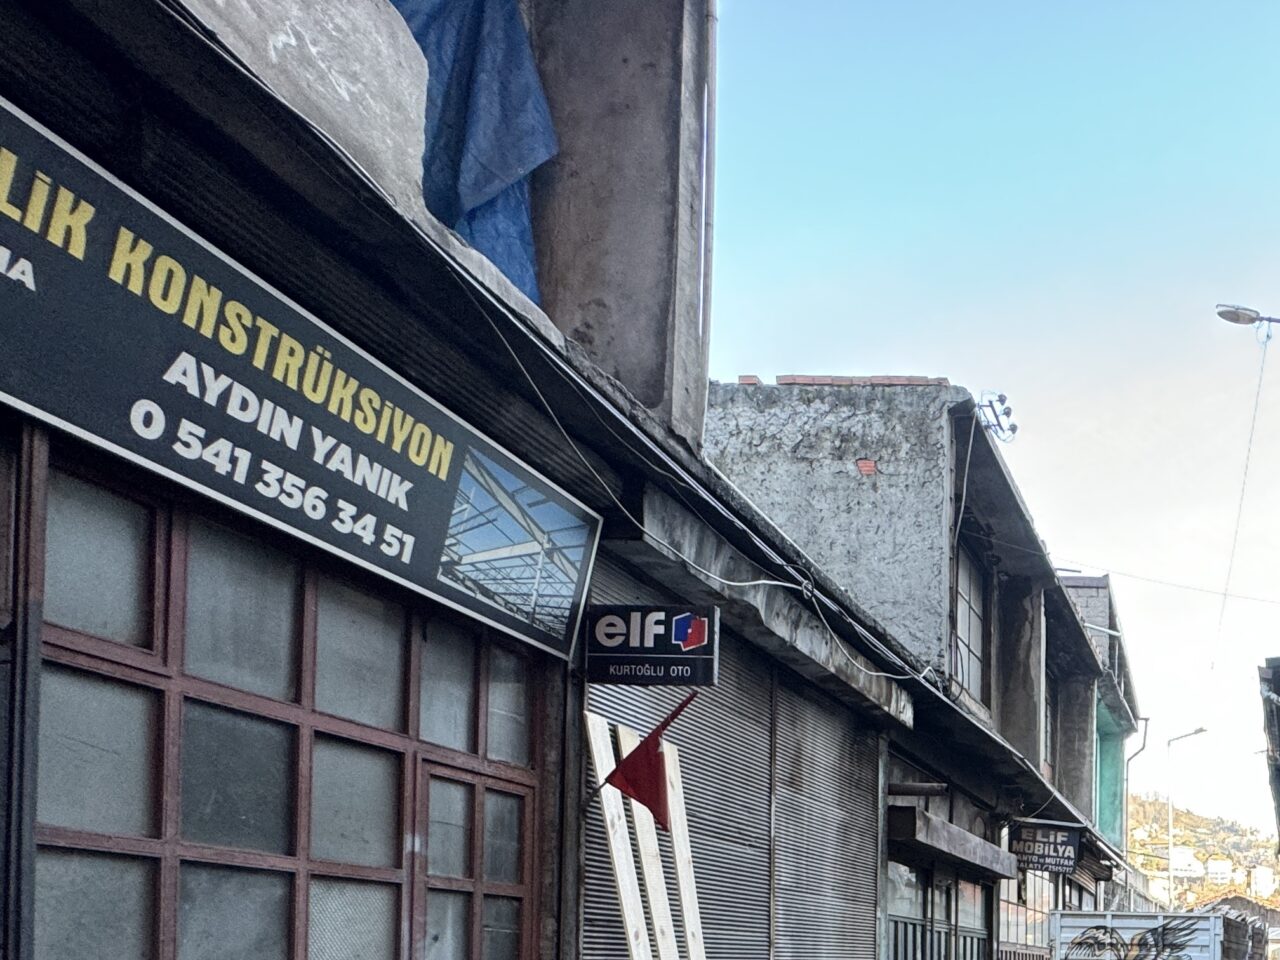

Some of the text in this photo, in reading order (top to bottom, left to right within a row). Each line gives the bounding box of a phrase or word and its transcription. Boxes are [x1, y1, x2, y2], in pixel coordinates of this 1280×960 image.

[109, 226, 455, 481] KONSTRÜKSİYON
[162, 351, 414, 512] AYDIN YANIK
[172, 418, 252, 484] 541
[255, 459, 329, 521] 356
[332, 499, 377, 546] 34
[379, 523, 415, 564] 51
[595, 611, 666, 648] elf
[609, 664, 691, 676] KURTOĞLU OTO
[1012, 840, 1075, 858] MOBİLYA
[1021, 828, 1069, 844] ELİF
[1045, 857, 1075, 866] MUTFAK
